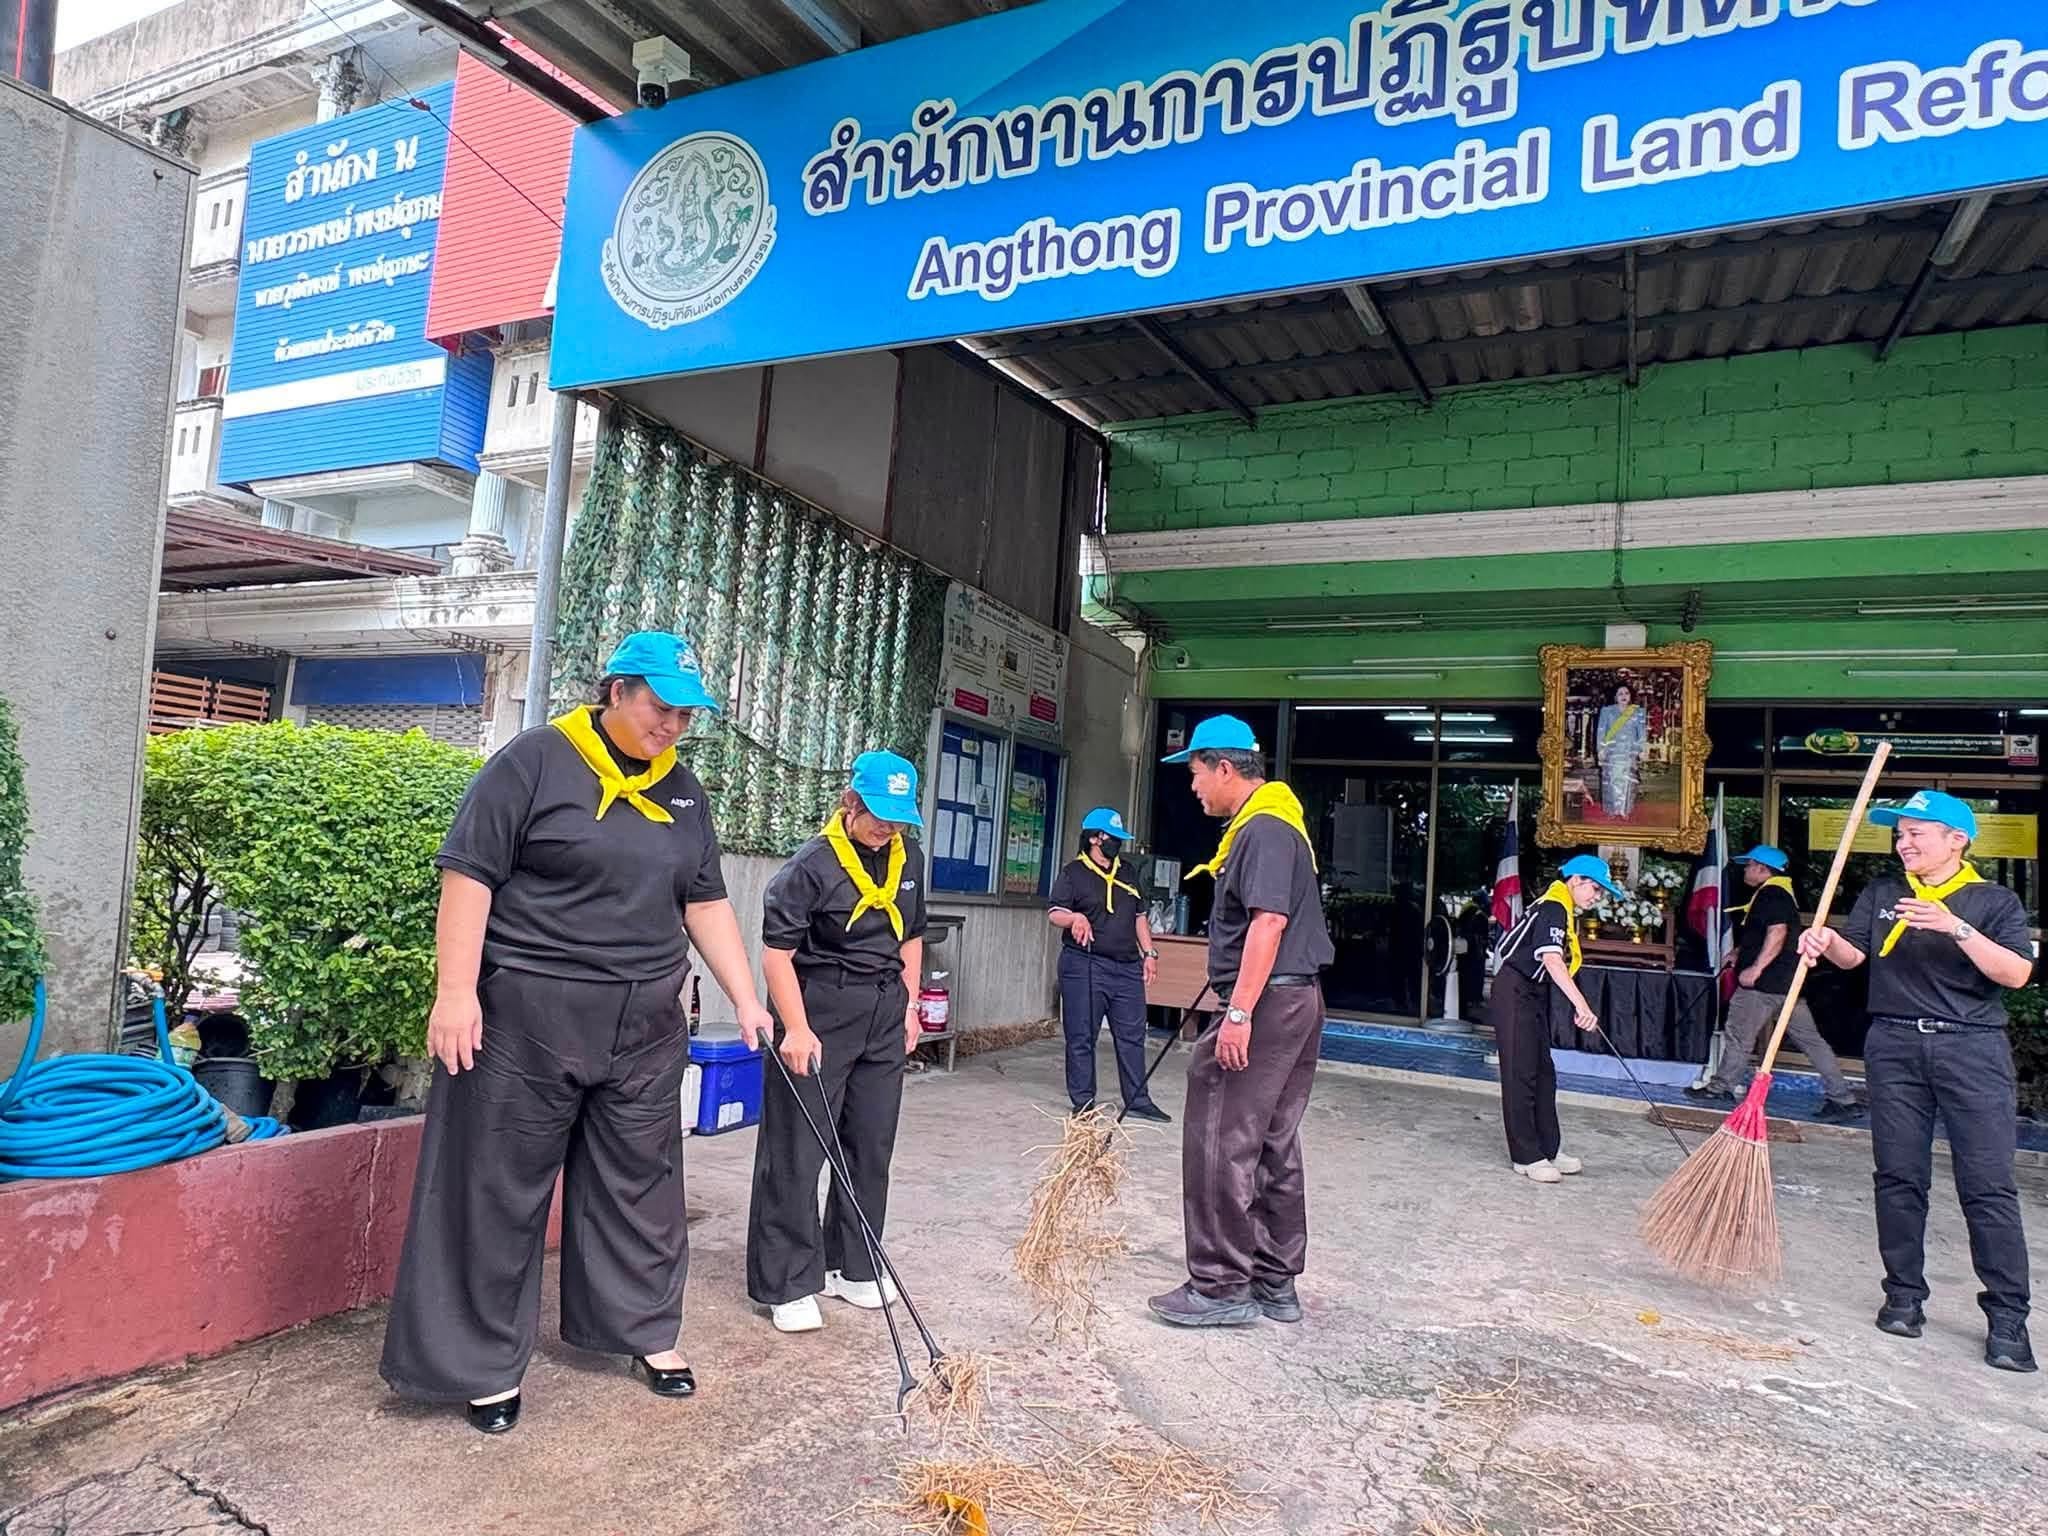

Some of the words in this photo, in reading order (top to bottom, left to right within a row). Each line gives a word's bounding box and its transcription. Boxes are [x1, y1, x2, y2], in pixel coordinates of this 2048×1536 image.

[913, 213, 1175, 293] Angthong
[1210, 135, 1540, 247] Provincial
[1590, 89, 1790, 185] Land
